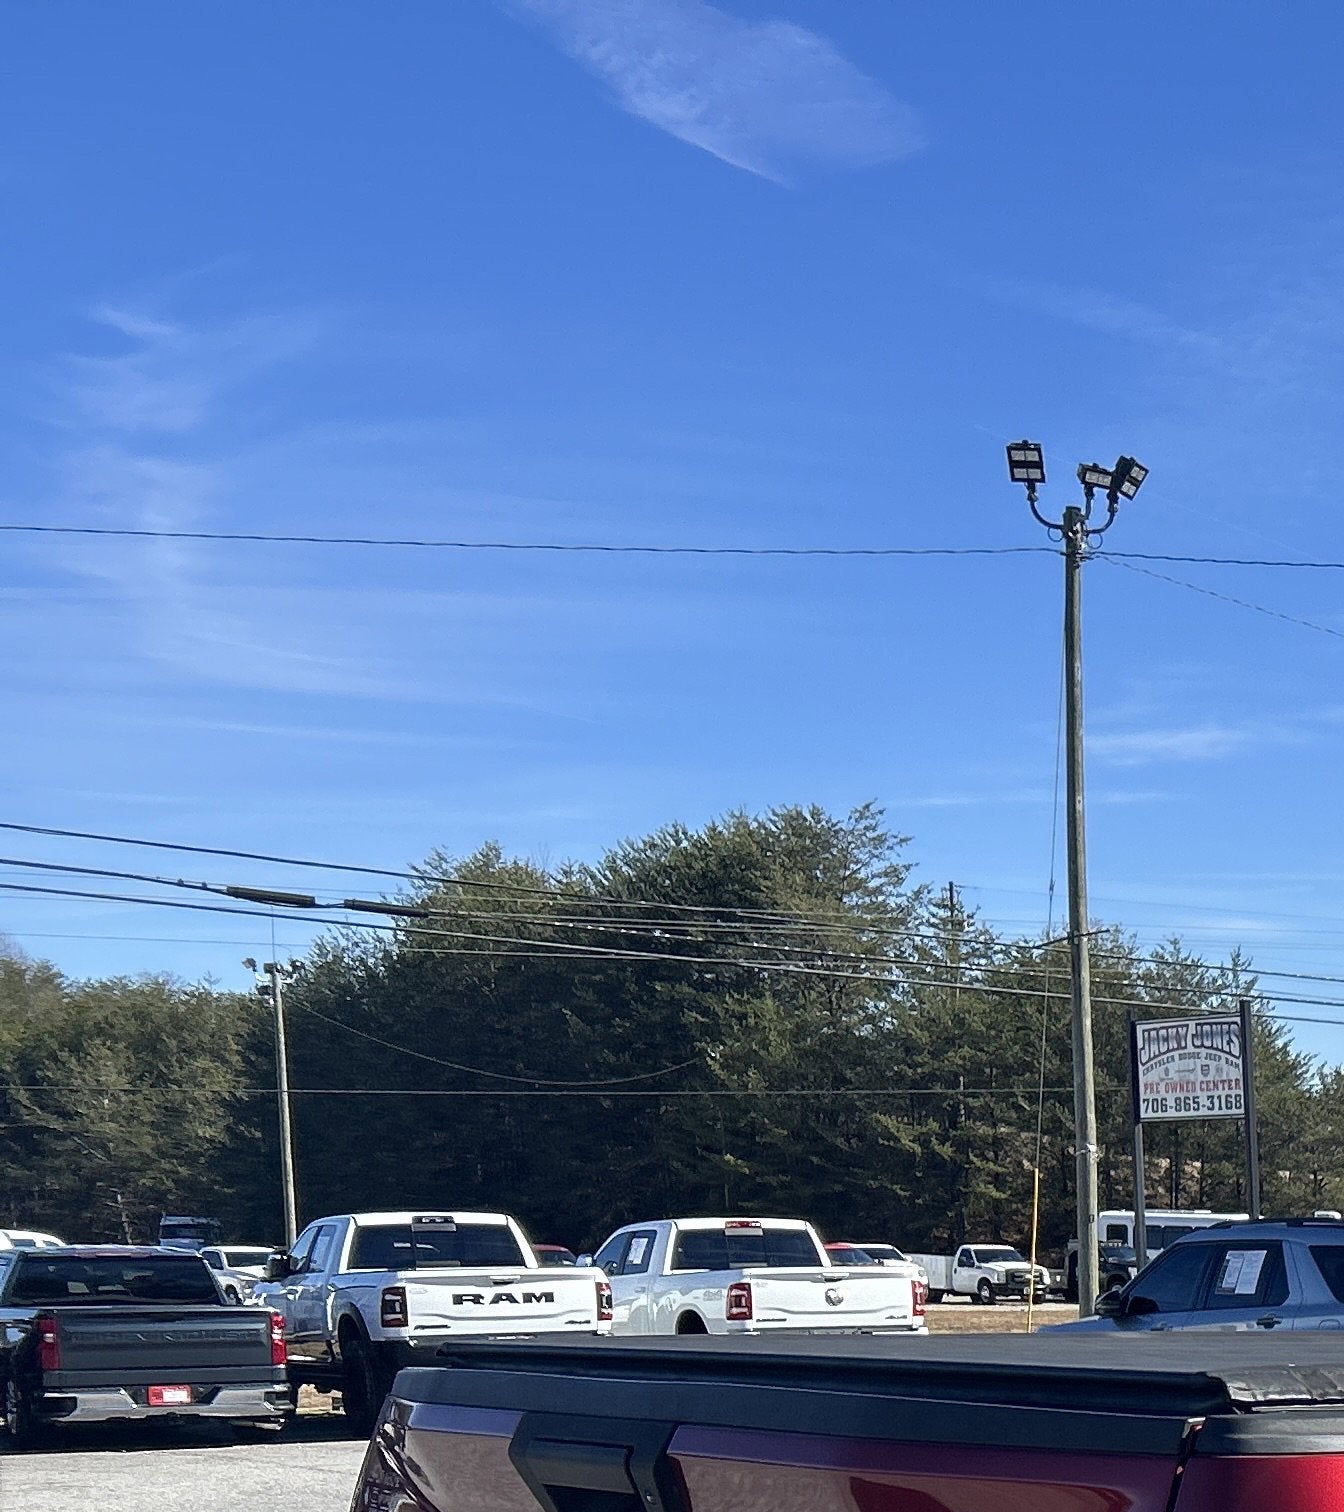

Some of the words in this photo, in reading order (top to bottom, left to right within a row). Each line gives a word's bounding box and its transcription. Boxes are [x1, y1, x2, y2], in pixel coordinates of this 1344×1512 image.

[1140, 1024, 1189, 1066] JACKY
[1192, 1022, 1241, 1060] JONES
[1142, 1055, 1175, 1077] CHRYSLER
[1204, 1052, 1222, 1062] JEEP
[1143, 1082, 1161, 1095] PRE
[1164, 1081, 1197, 1094] OWNED
[1199, 1078, 1242, 1092] CENTER
[1142, 1093, 1243, 1114] 706-865-3168
[451, 1291, 555, 1306] RAM
